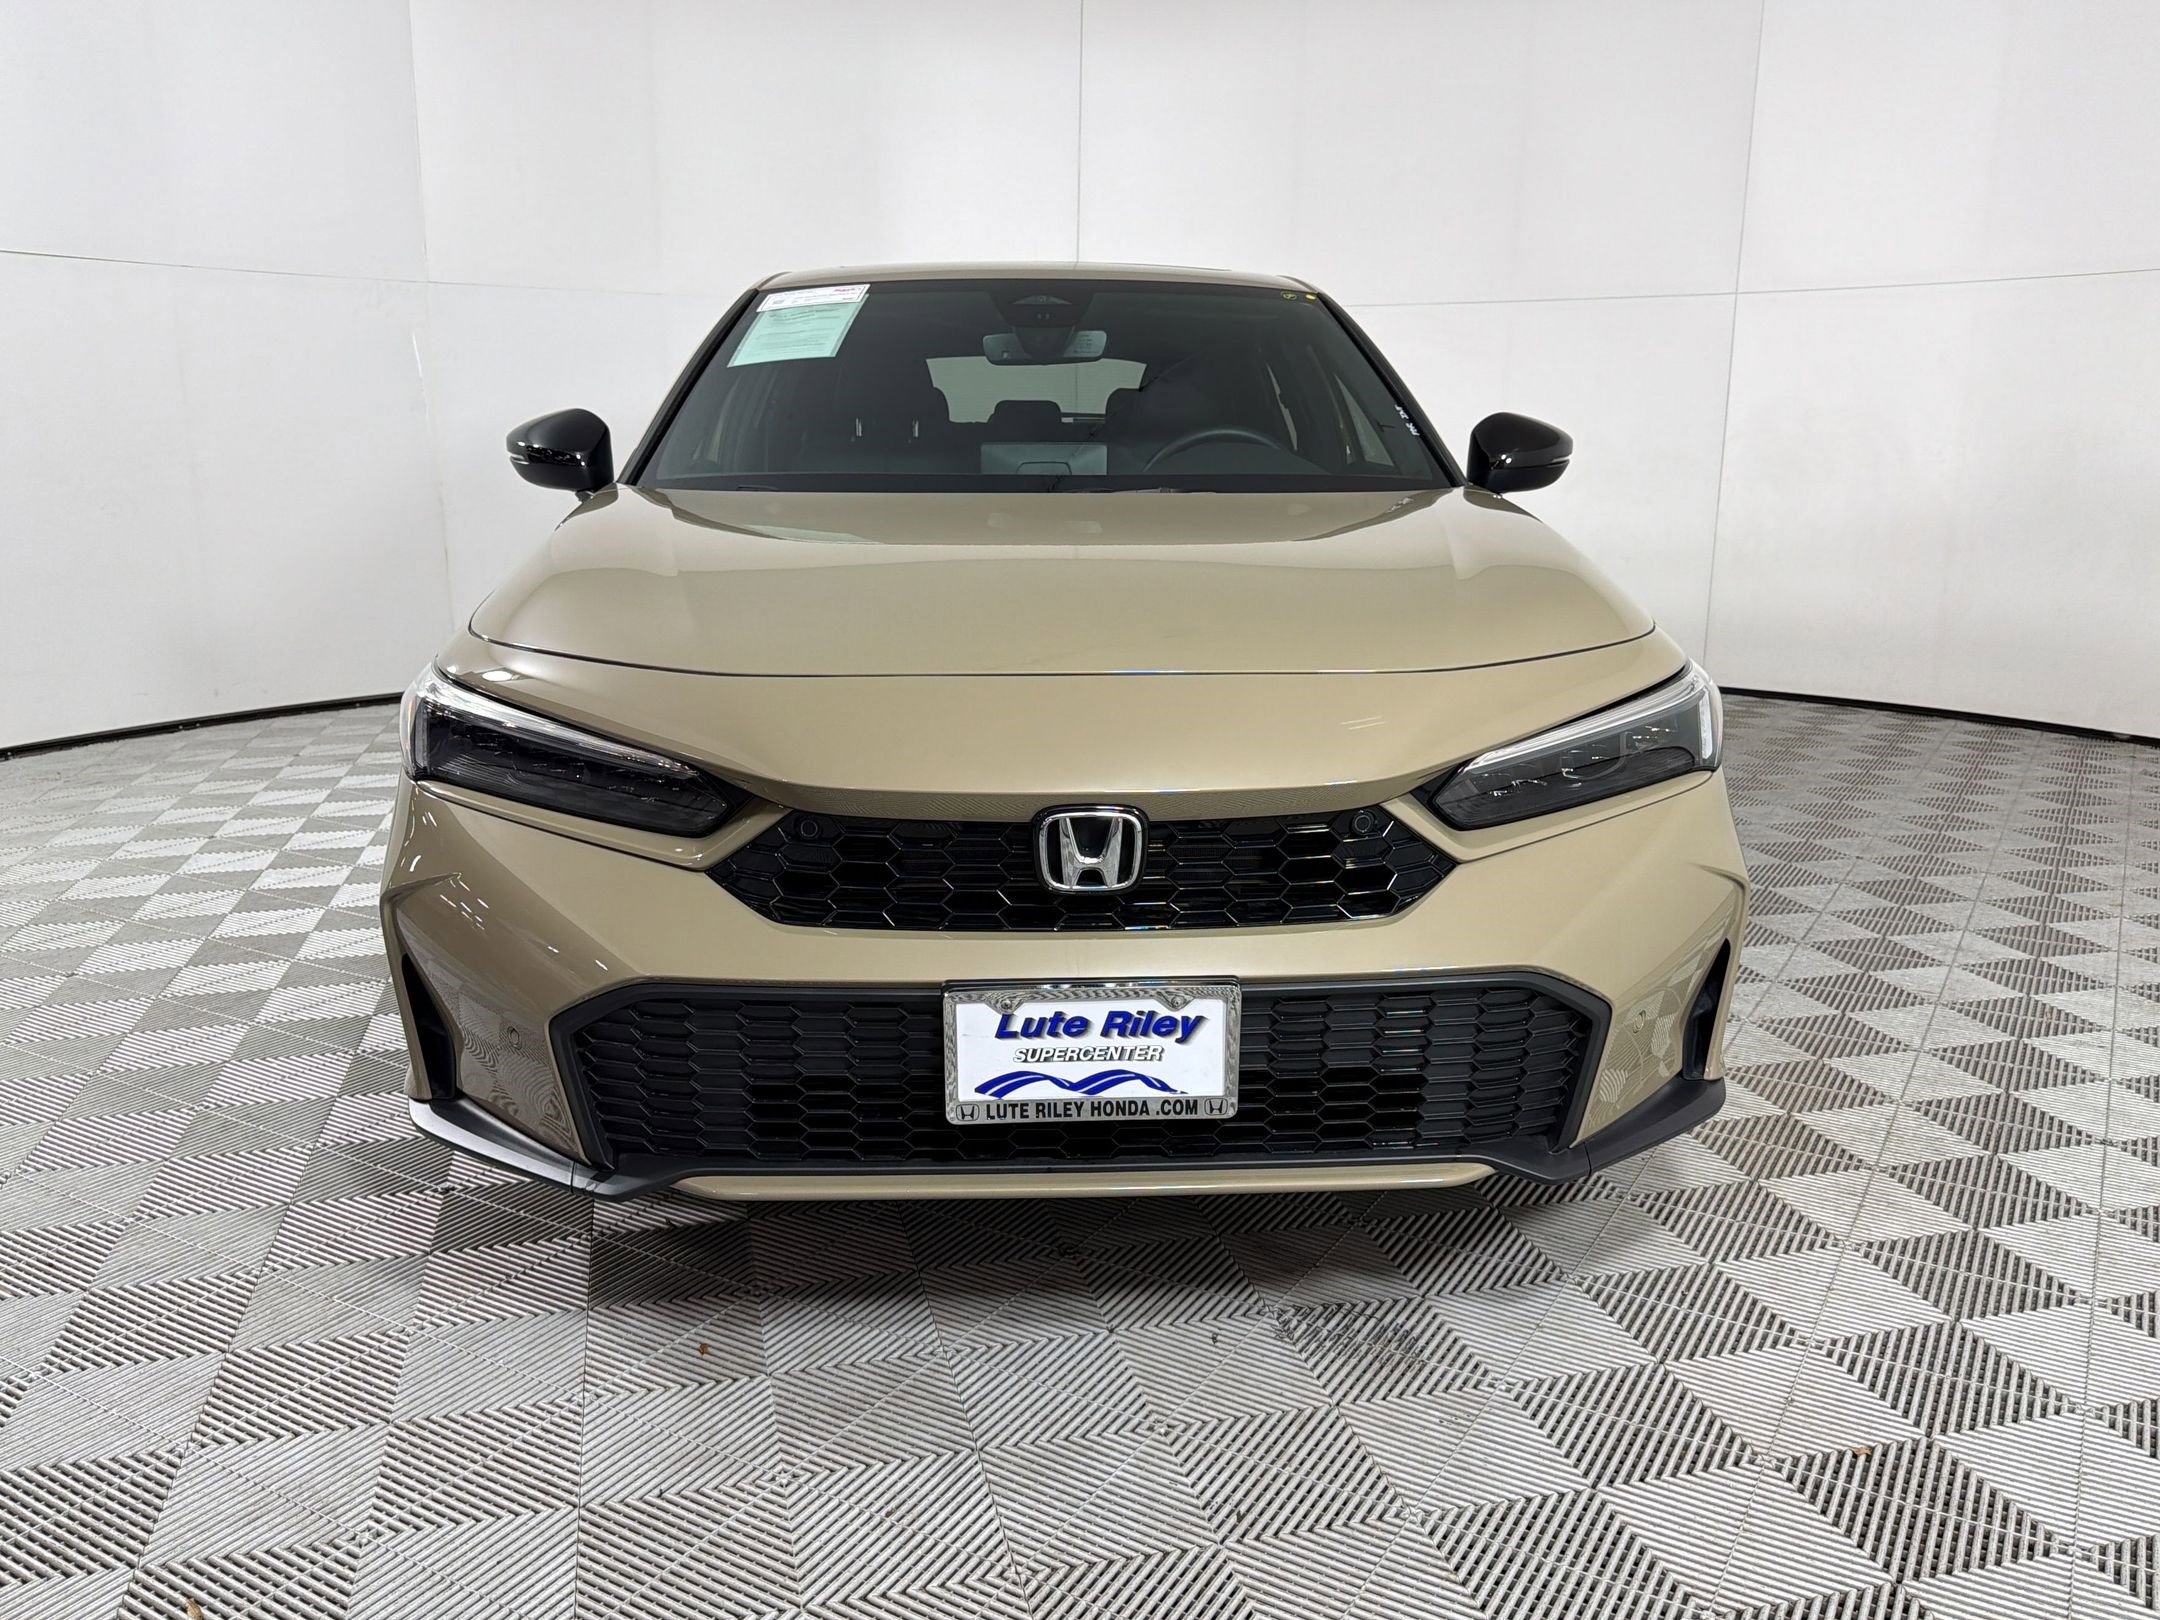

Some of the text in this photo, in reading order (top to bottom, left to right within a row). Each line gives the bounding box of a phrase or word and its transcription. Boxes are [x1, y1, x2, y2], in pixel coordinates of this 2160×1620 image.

[995, 1010, 1206, 1043] Lute Riley
[1013, 1045, 1164, 1062] SUPERCENTER
[986, 1103, 1029, 1120] LUTE
[1035, 1101, 1083, 1119] RILEY
[1090, 1098, 1149, 1117] HONDA
